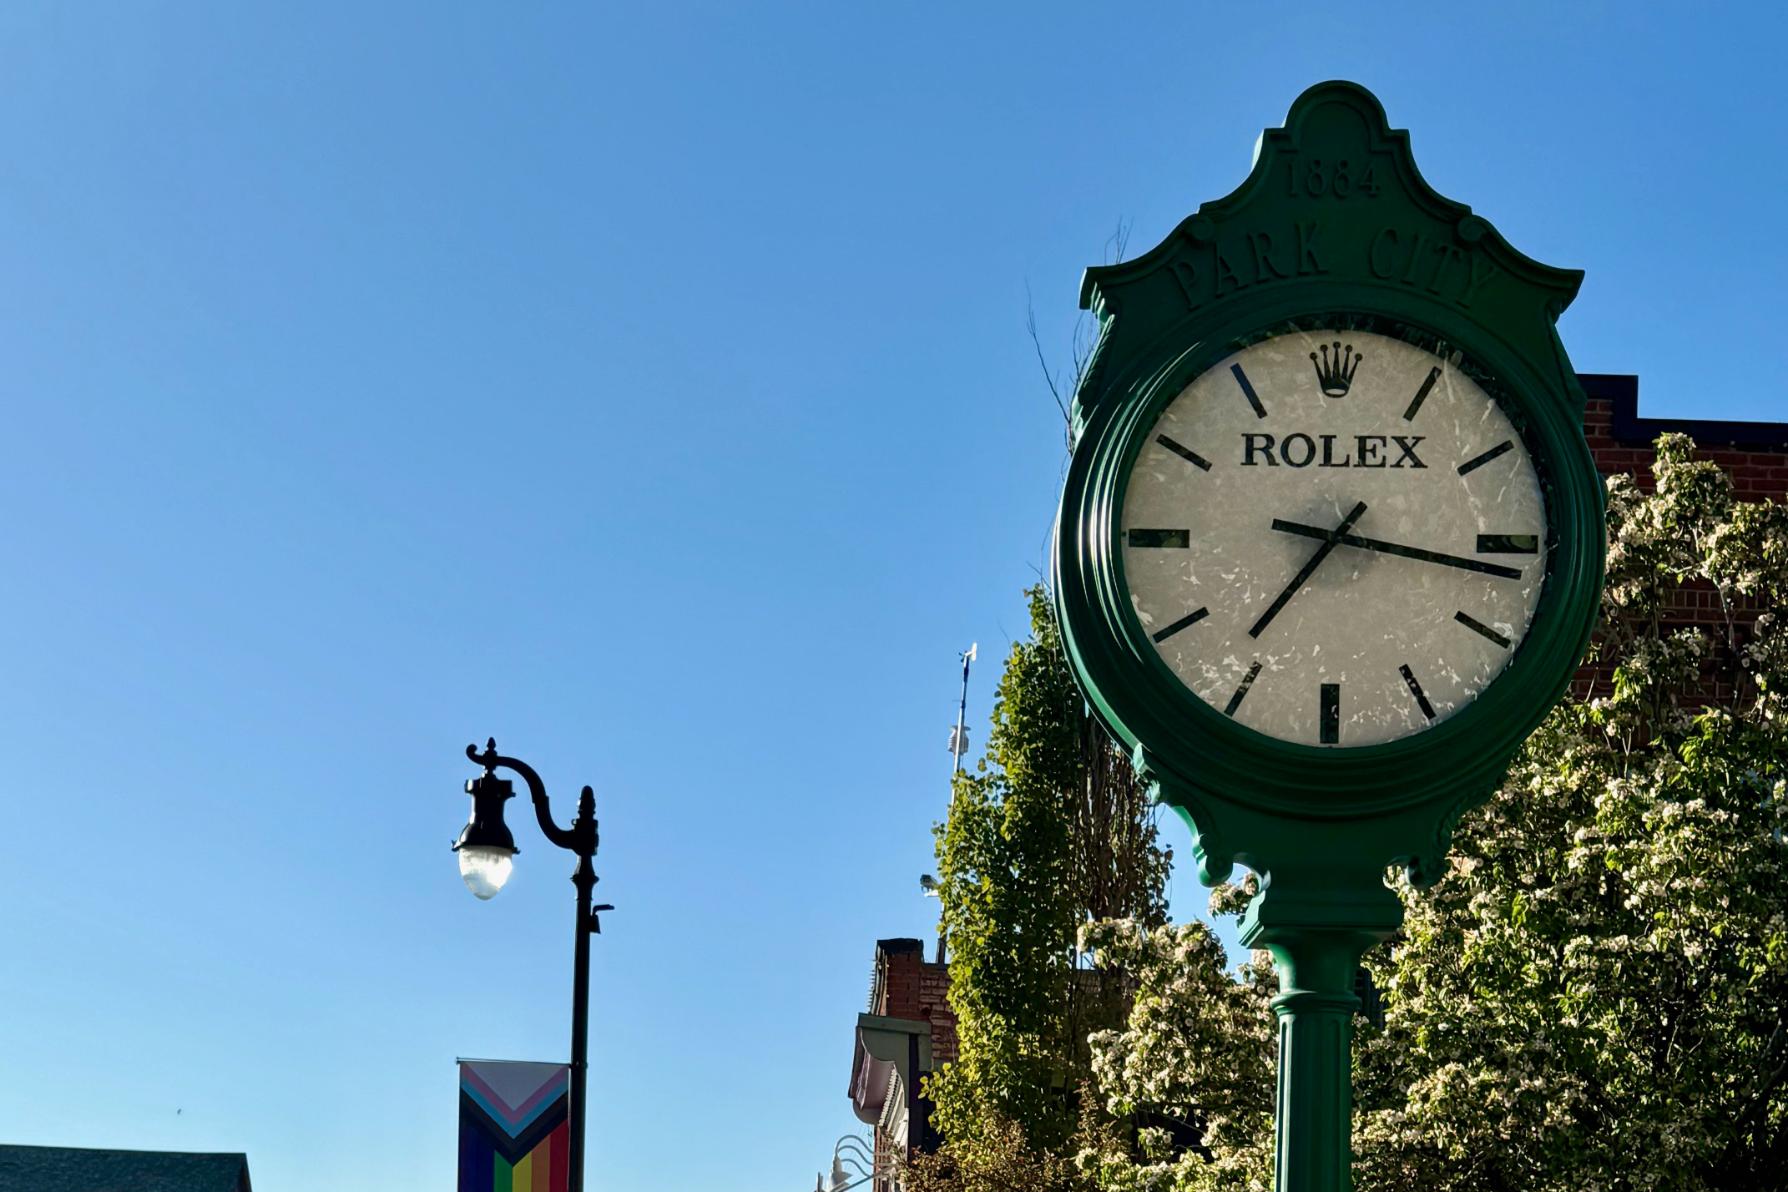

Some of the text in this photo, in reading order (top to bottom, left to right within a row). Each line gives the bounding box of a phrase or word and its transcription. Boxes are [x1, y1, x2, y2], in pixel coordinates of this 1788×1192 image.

[1288, 159, 1380, 199] 1884
[1168, 220, 1499, 311] PARK CITY
[1240, 432, 1429, 469] ROLEX
